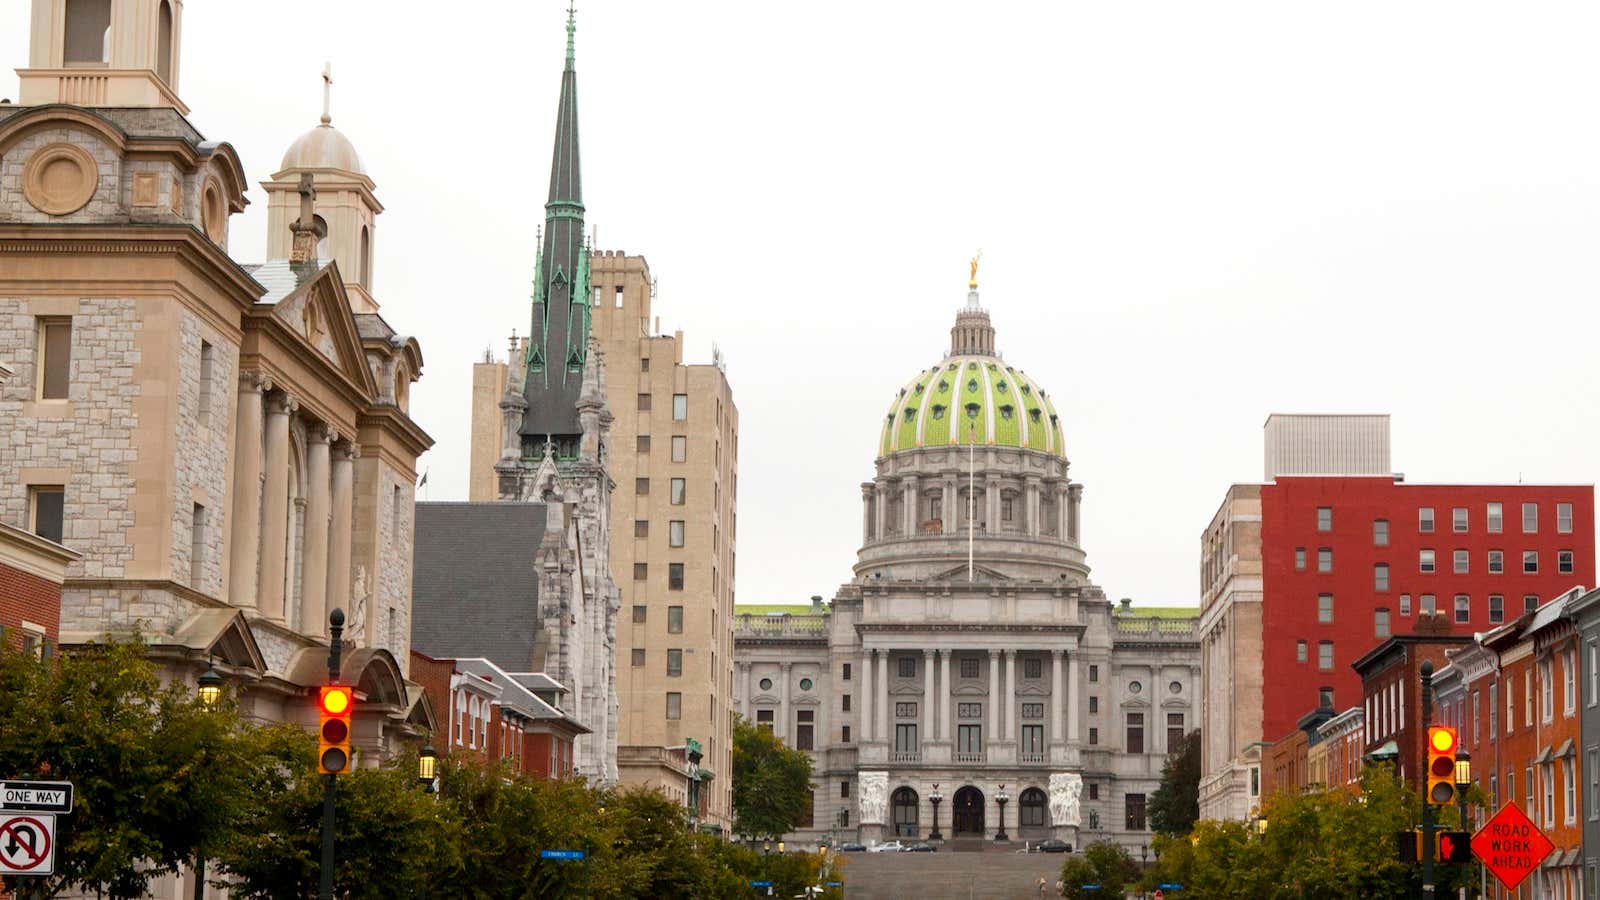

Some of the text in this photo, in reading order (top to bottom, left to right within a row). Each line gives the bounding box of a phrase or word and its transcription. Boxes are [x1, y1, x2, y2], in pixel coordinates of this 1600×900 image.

[6, 791, 61, 803] ONE WAY
[1492, 823, 1530, 837] ROAD
[1492, 839, 1530, 852] WORK
[1492, 855, 1531, 869] AHEAD
